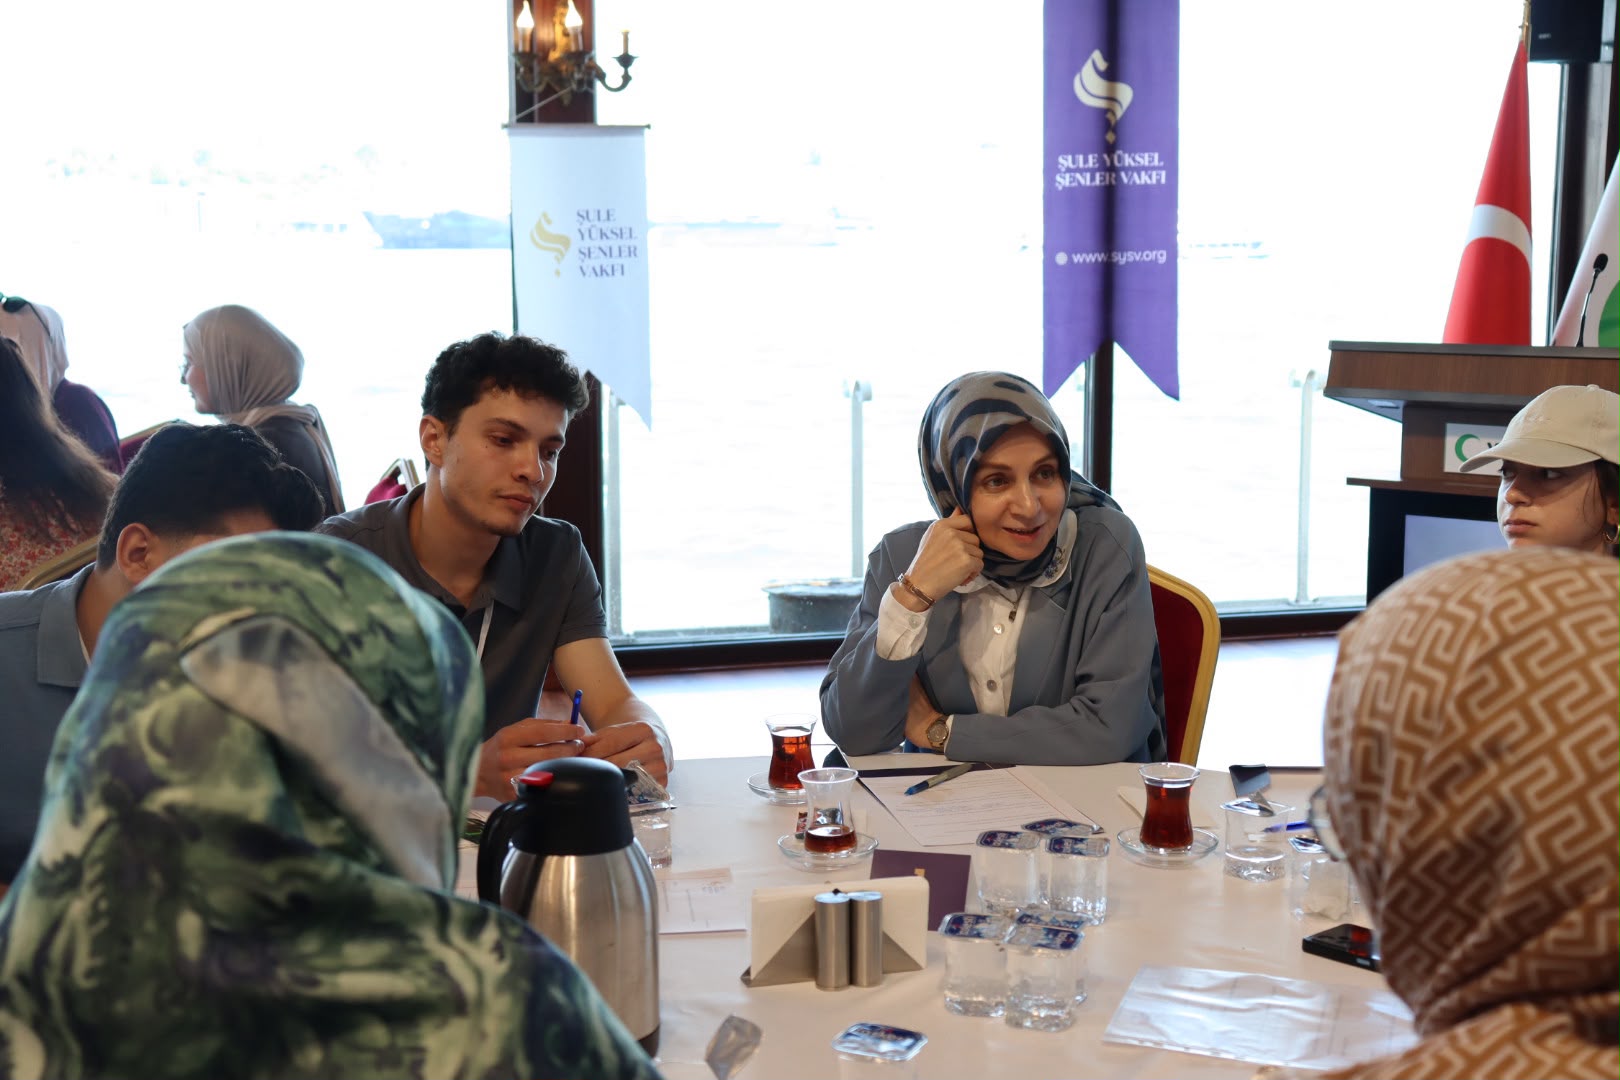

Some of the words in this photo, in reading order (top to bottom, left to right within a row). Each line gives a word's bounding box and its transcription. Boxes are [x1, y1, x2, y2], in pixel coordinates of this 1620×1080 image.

[1058, 154, 1099, 172] ŞULE
[1103, 150, 1164, 167] YÜKSEL
[1055, 172, 1116, 190] ŞENLER
[1120, 170, 1166, 185] VAKFI
[577, 209, 616, 225] ŞULE
[577, 225, 638, 241] YÜKSEL
[578, 245, 638, 262] ŞENLER
[1072, 250, 1167, 265] www.sysv.org
[579, 263, 625, 278] VAKFI
